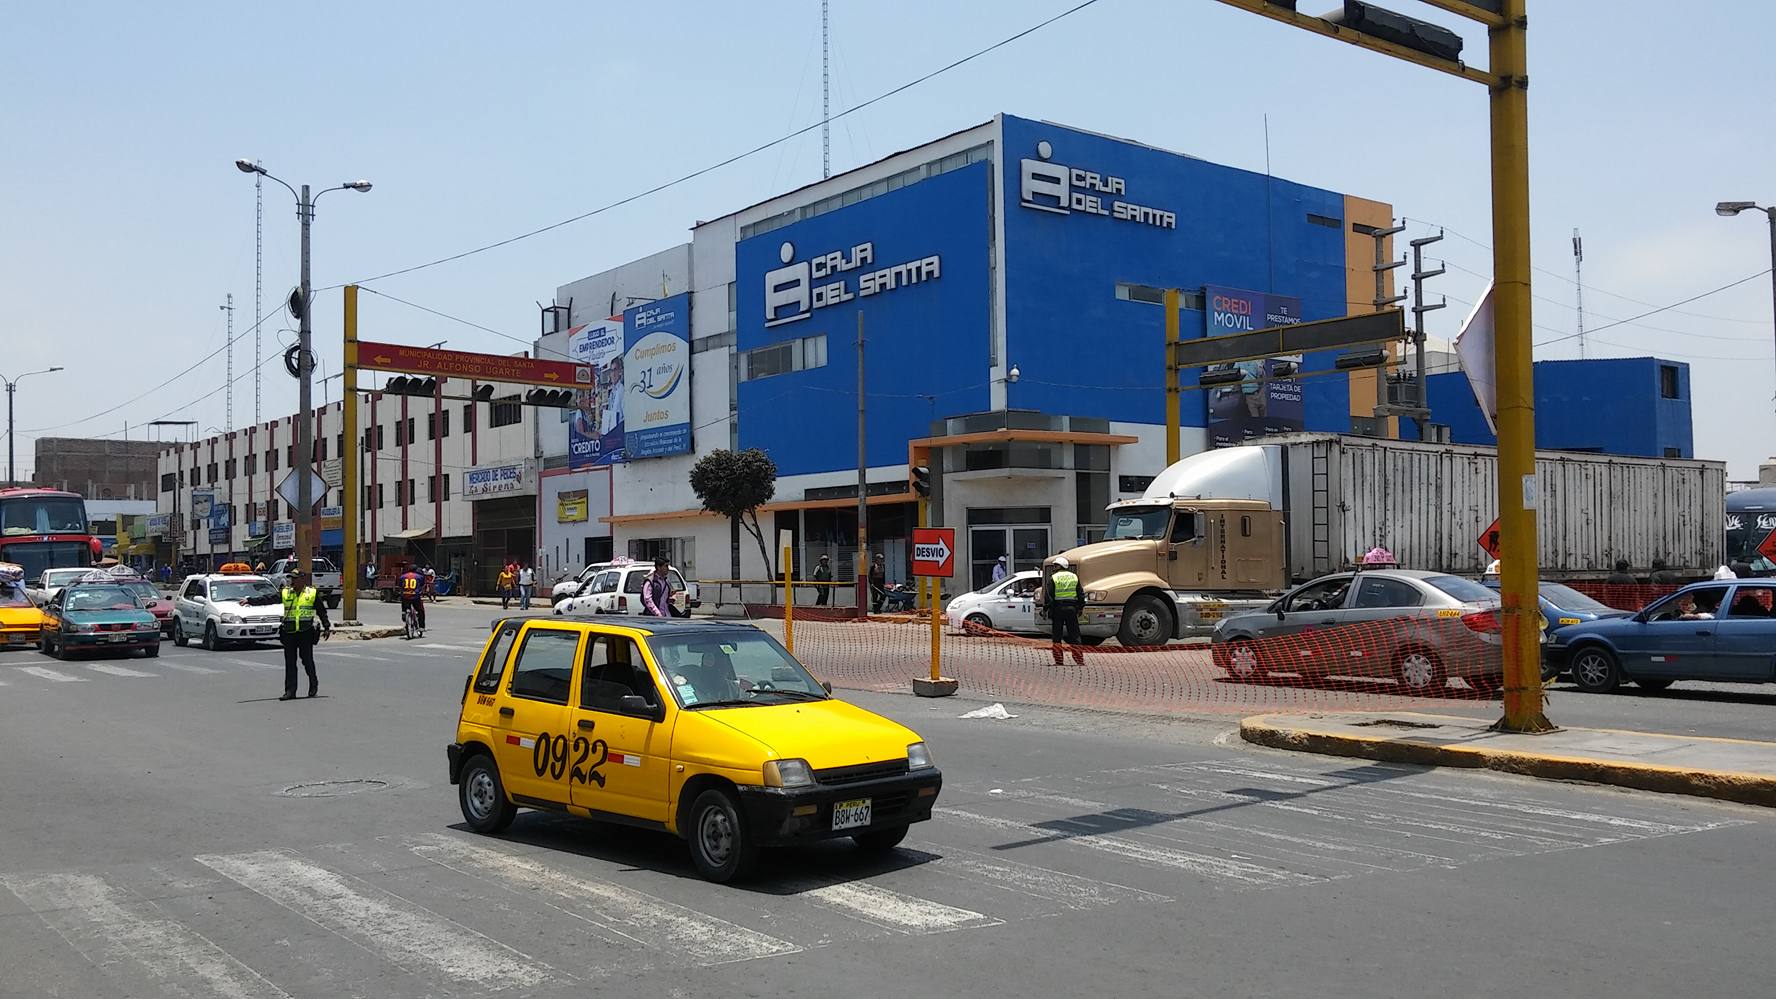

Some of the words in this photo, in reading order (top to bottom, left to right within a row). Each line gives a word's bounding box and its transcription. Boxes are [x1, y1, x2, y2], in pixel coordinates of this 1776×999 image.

[1070, 168, 1125, 195] CAJA
[1070, 196, 1109, 215] DEL
[1112, 200, 1176, 229] SANTA
[812, 242, 873, 279] CAJA
[812, 281, 854, 309] DEL
[859, 255, 940, 296] SANTA
[1213, 296, 1252, 314] CREDI
[1280, 306, 1288, 315] TE
[1214, 312, 1254, 331] MOVIL
[1266, 313, 1300, 325] PRESTAMOS
[579, 336, 615, 353] EMPRENDEDOR
[635, 343, 676, 360] Cumplimos
[399, 349, 453, 361] MUNICIPALIDAD
[456, 354, 495, 365] PROVINCIAL
[514, 360, 535, 369] SANTA
[417, 360, 432, 369] JR.
[436, 361, 481, 373] ALFONSO
[486, 366, 521, 377] UGARTE
[639, 367, 653, 393] 31
[656, 363, 673, 375] años
[1269, 383, 1293, 392] TARJETA
[1293, 385, 1302, 393] DE
[1270, 392, 1301, 402] PROPIEDAD
[643, 409, 669, 423] Juntos
[492, 469, 499, 481] DE
[916, 547, 945, 558] DESVIO
[1219, 513, 1227, 580] INTERNATIONAL
[404, 578, 417, 589] 10
[533, 732, 608, 788] 0922
[835, 806, 870, 826] B8W-667
